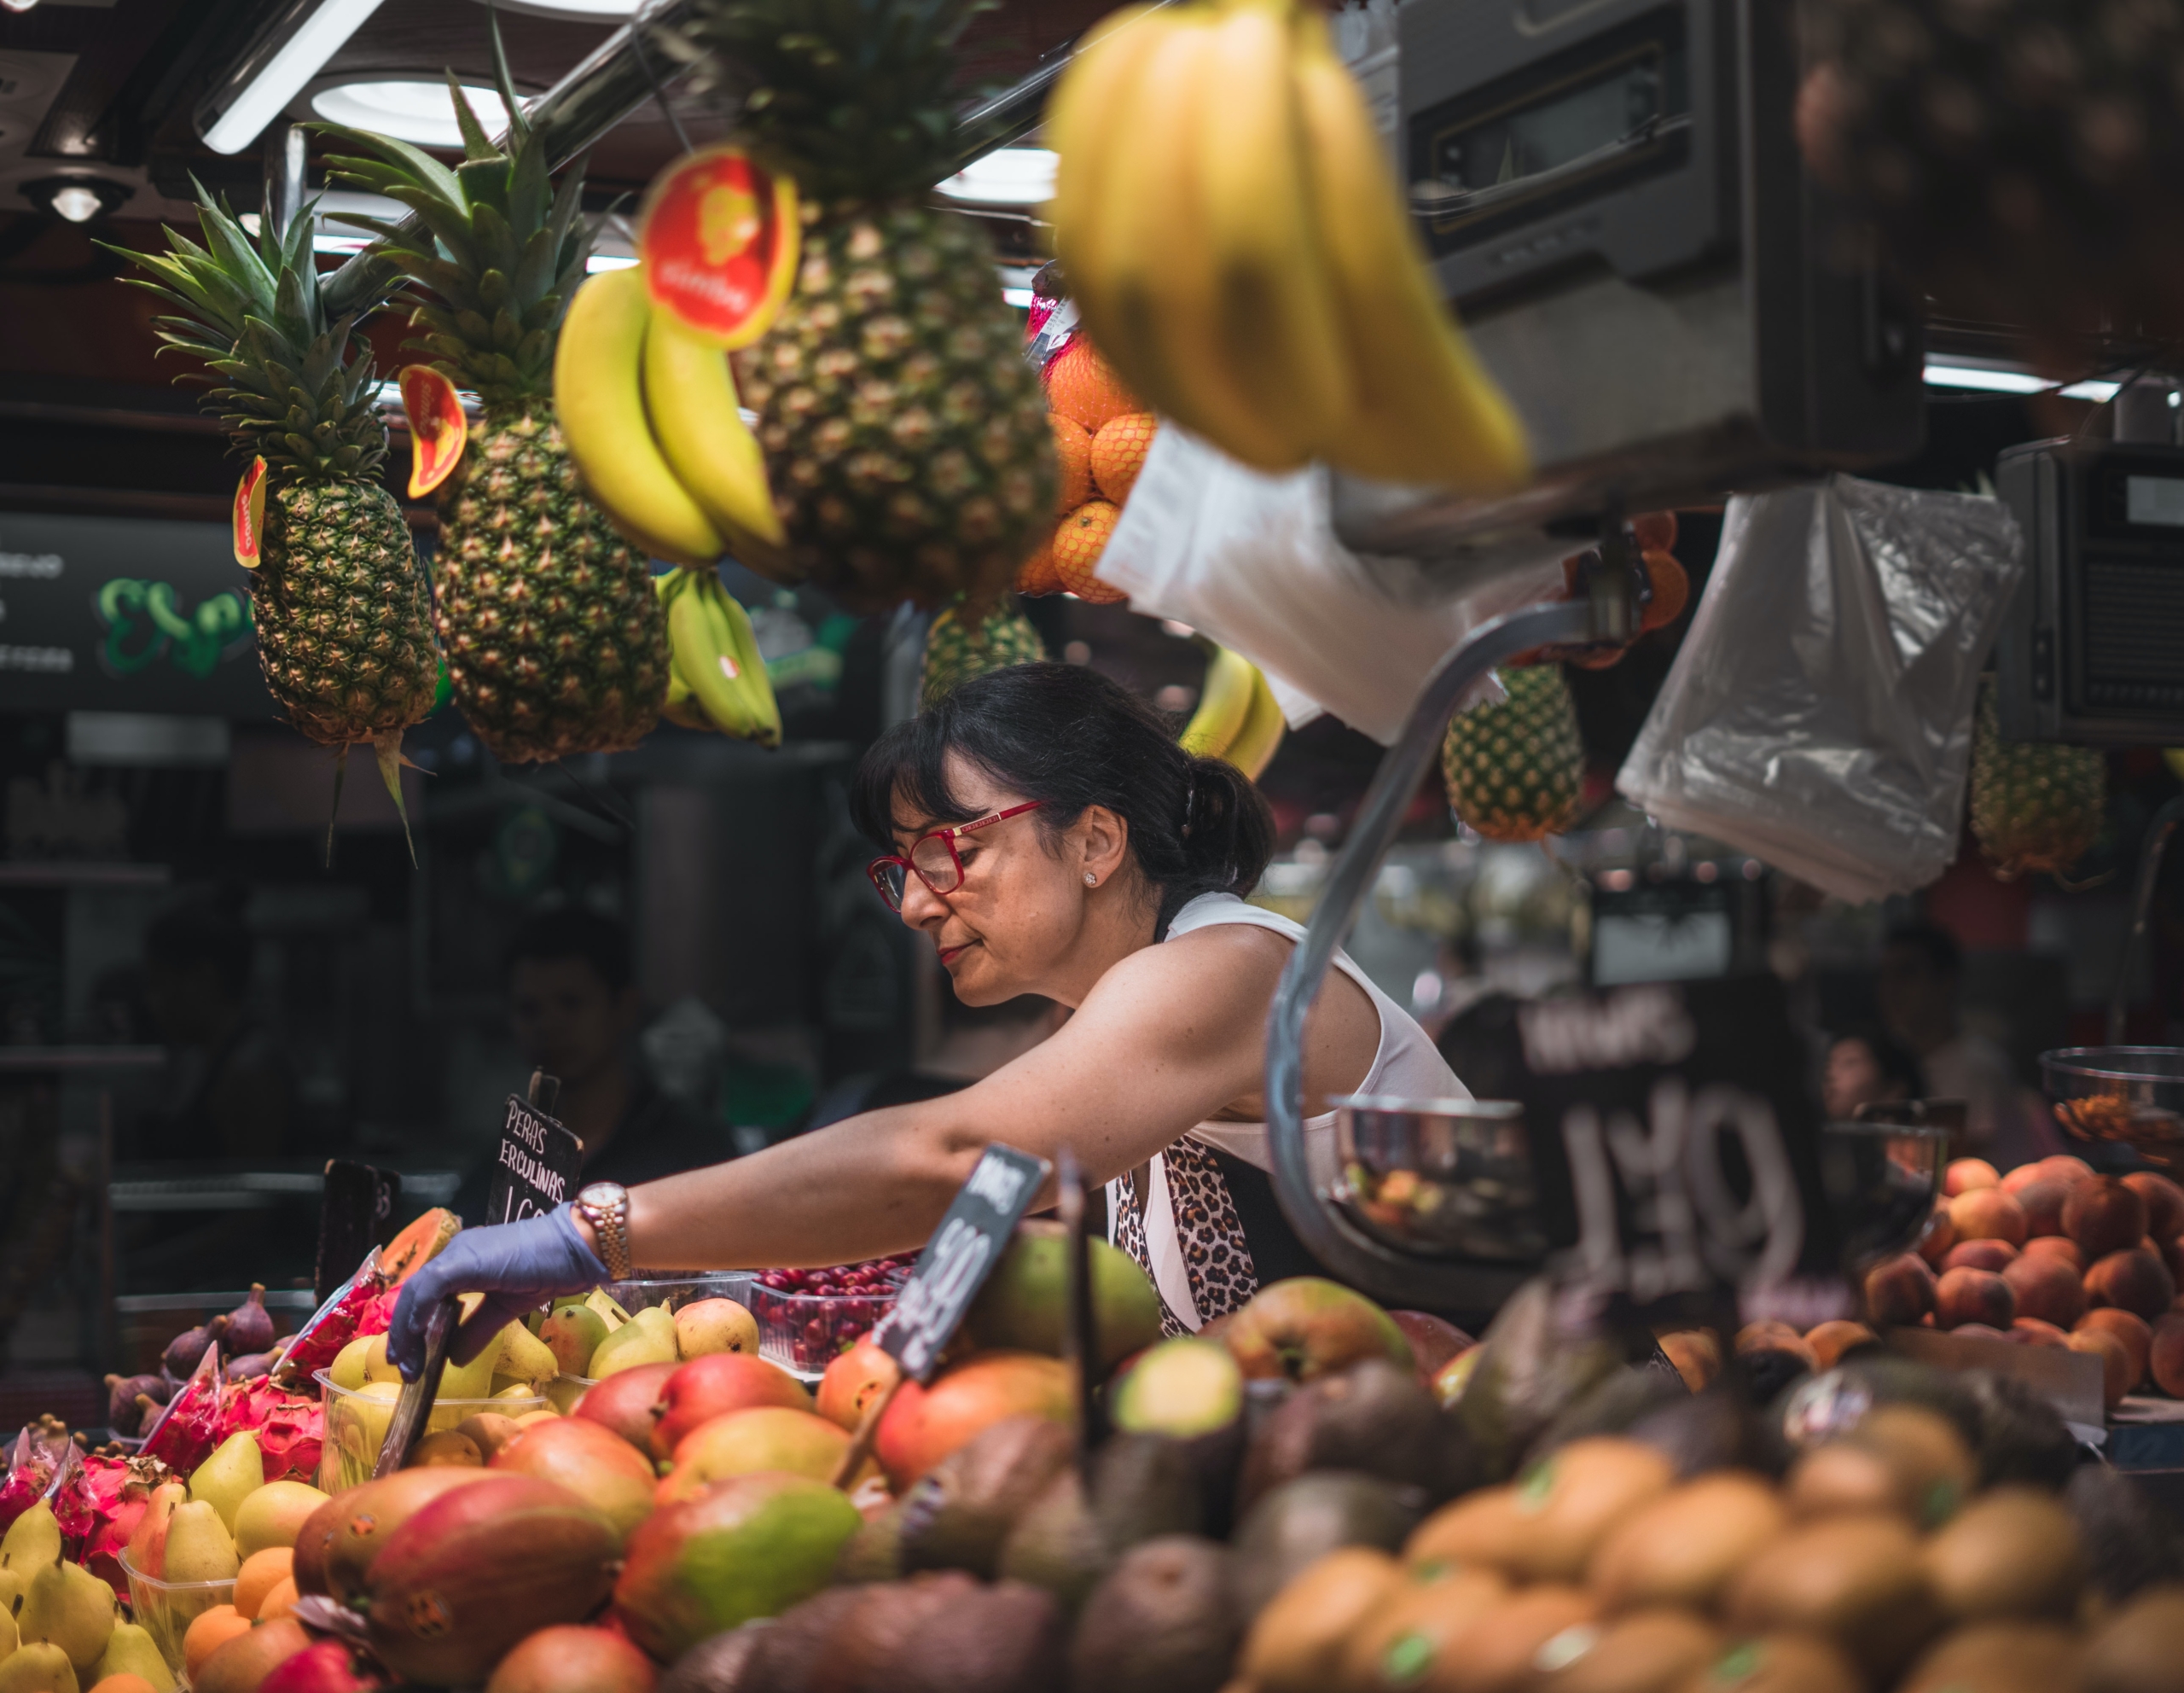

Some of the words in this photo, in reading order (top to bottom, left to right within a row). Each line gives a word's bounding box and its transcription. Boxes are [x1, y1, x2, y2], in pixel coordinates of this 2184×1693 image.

[241, 494, 253, 550] simba
[505, 1099, 548, 1155] PERAS
[498, 1137, 566, 1205] ERCULINAS
